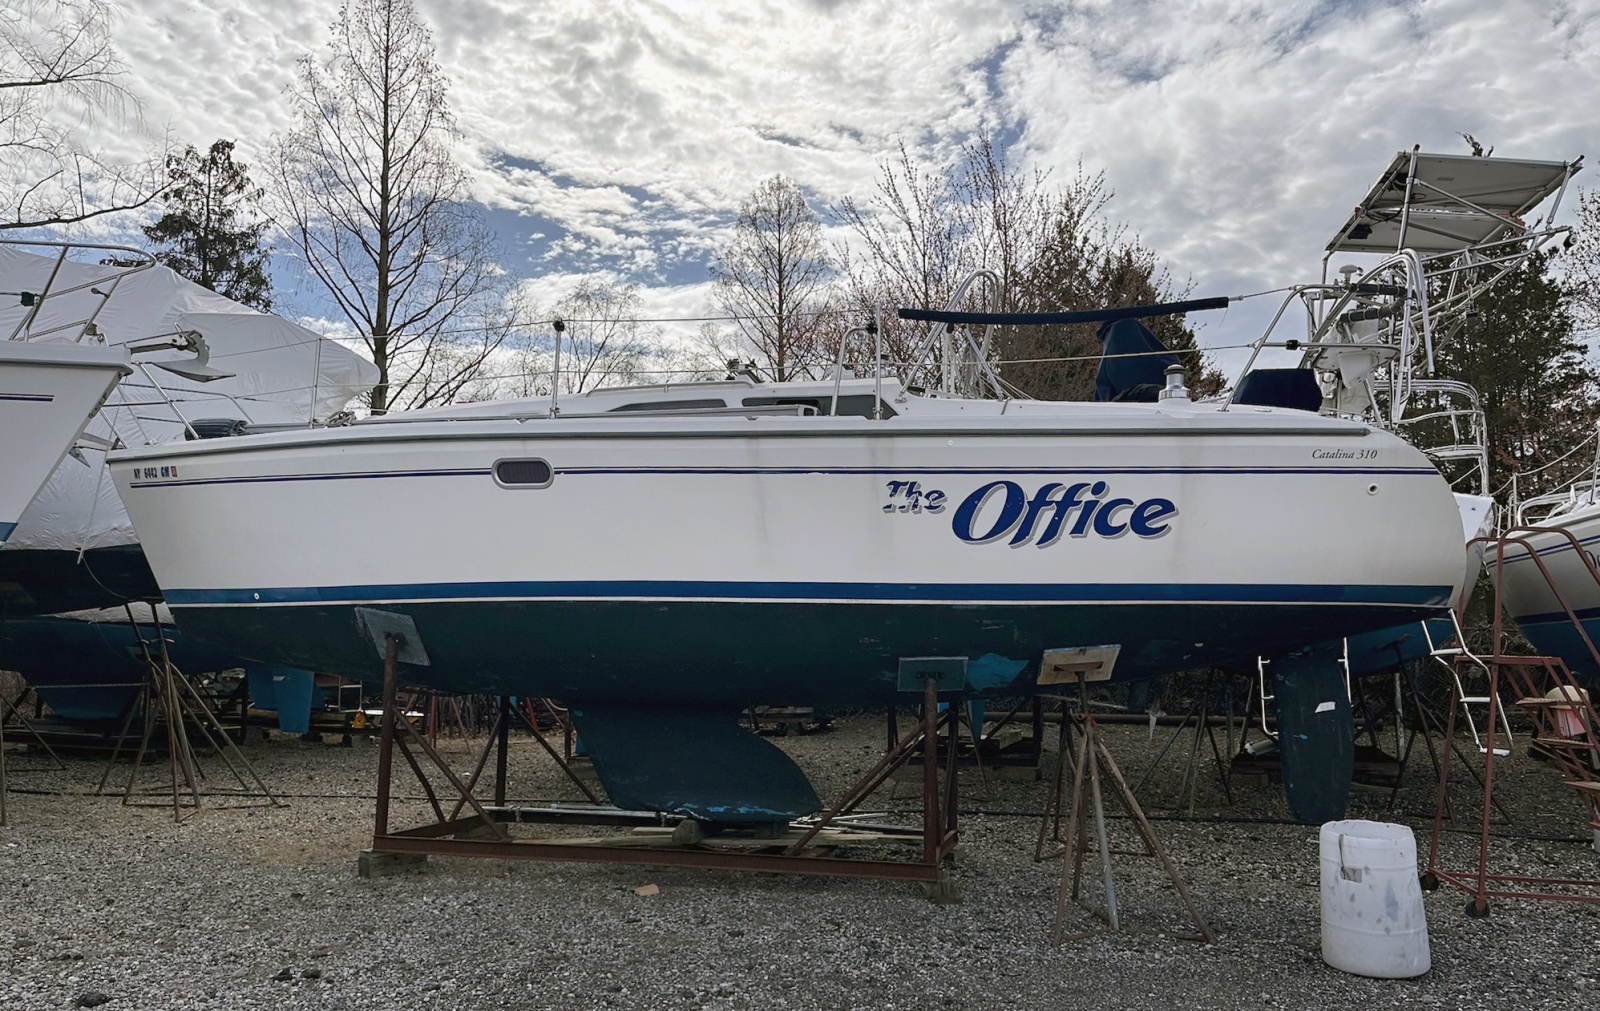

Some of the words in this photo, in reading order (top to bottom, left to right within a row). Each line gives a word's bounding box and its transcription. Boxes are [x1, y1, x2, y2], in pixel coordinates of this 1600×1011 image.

[1312, 448, 1354, 459] Catalina
[1357, 449, 1378, 460] 310
[882, 480, 947, 514] The
[952, 480, 1179, 549] Office
